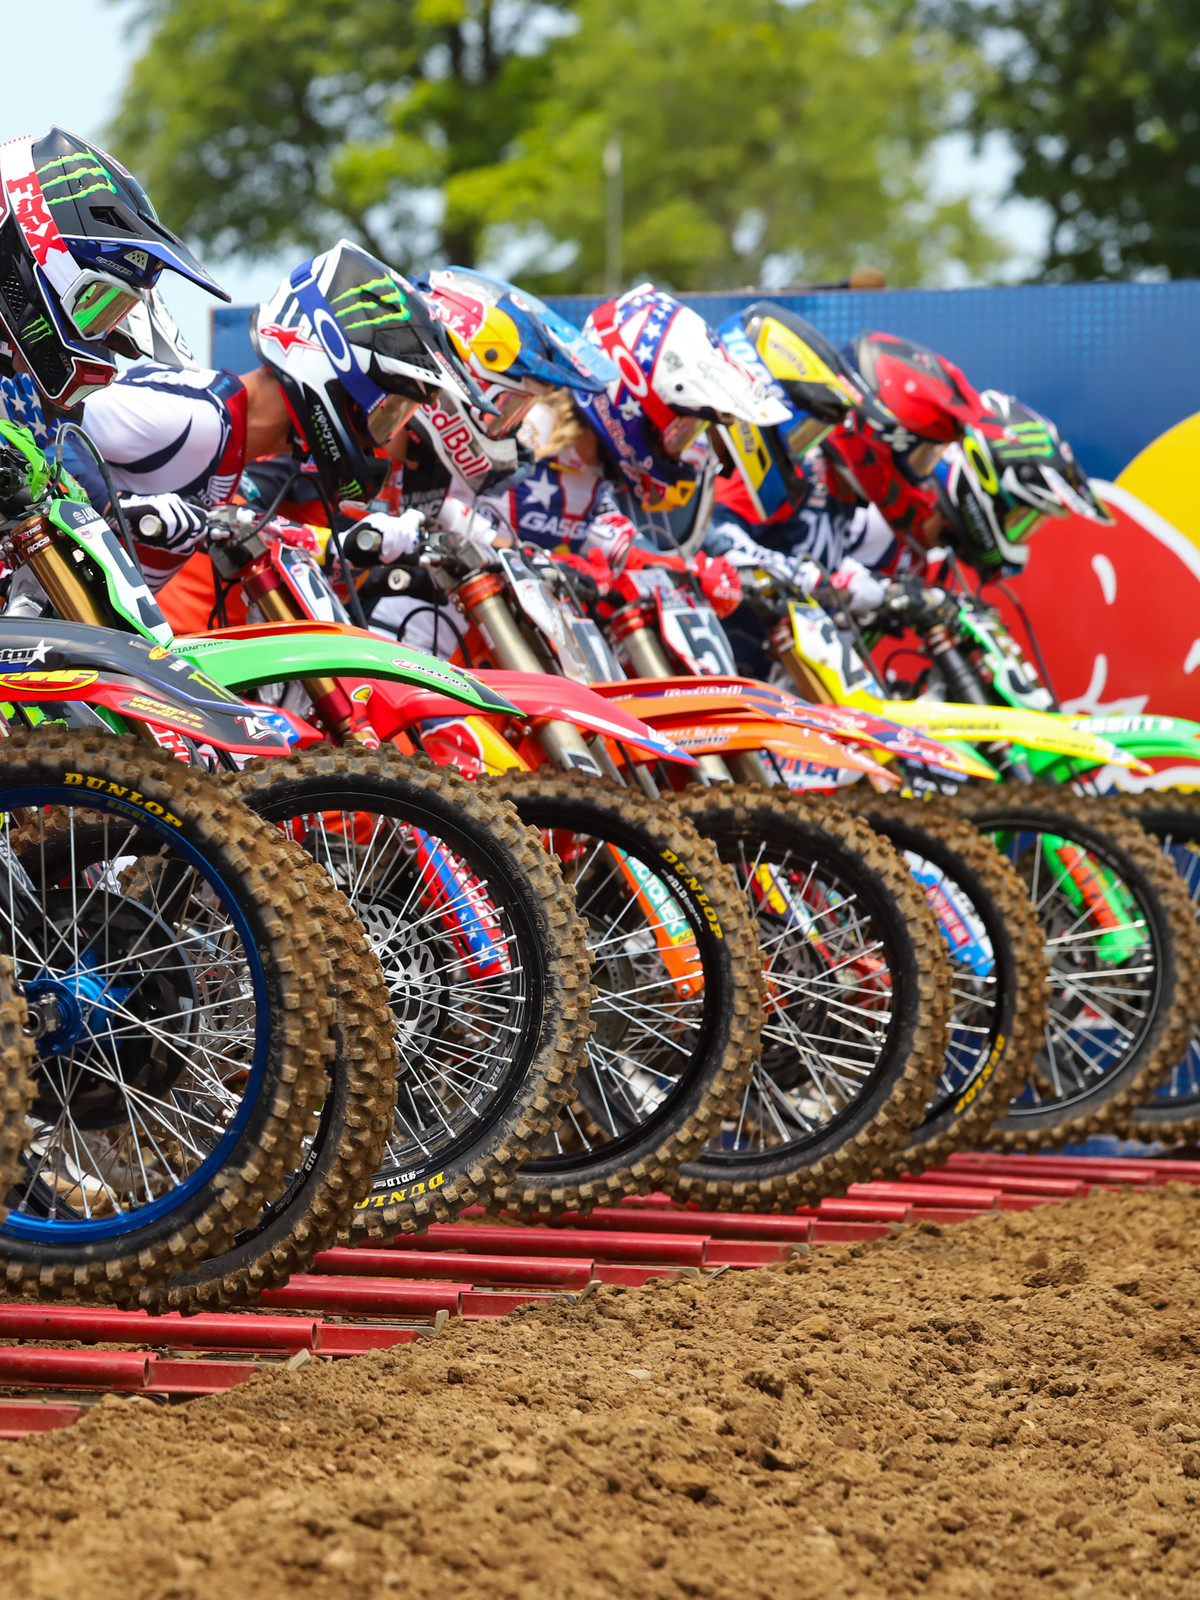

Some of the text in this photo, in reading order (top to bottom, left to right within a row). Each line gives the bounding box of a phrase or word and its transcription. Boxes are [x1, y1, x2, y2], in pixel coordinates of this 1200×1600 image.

[313, 403, 341, 462] MONSTER
[442, 424, 493, 479] Bull
[27, 537, 51, 555] ROCS
[63, 772, 184, 828] DUNLOP
[106, 799, 148, 824] EXCEL
[627, 855, 684, 934] MOTOREX
[659, 849, 723, 939] DUNLOP
